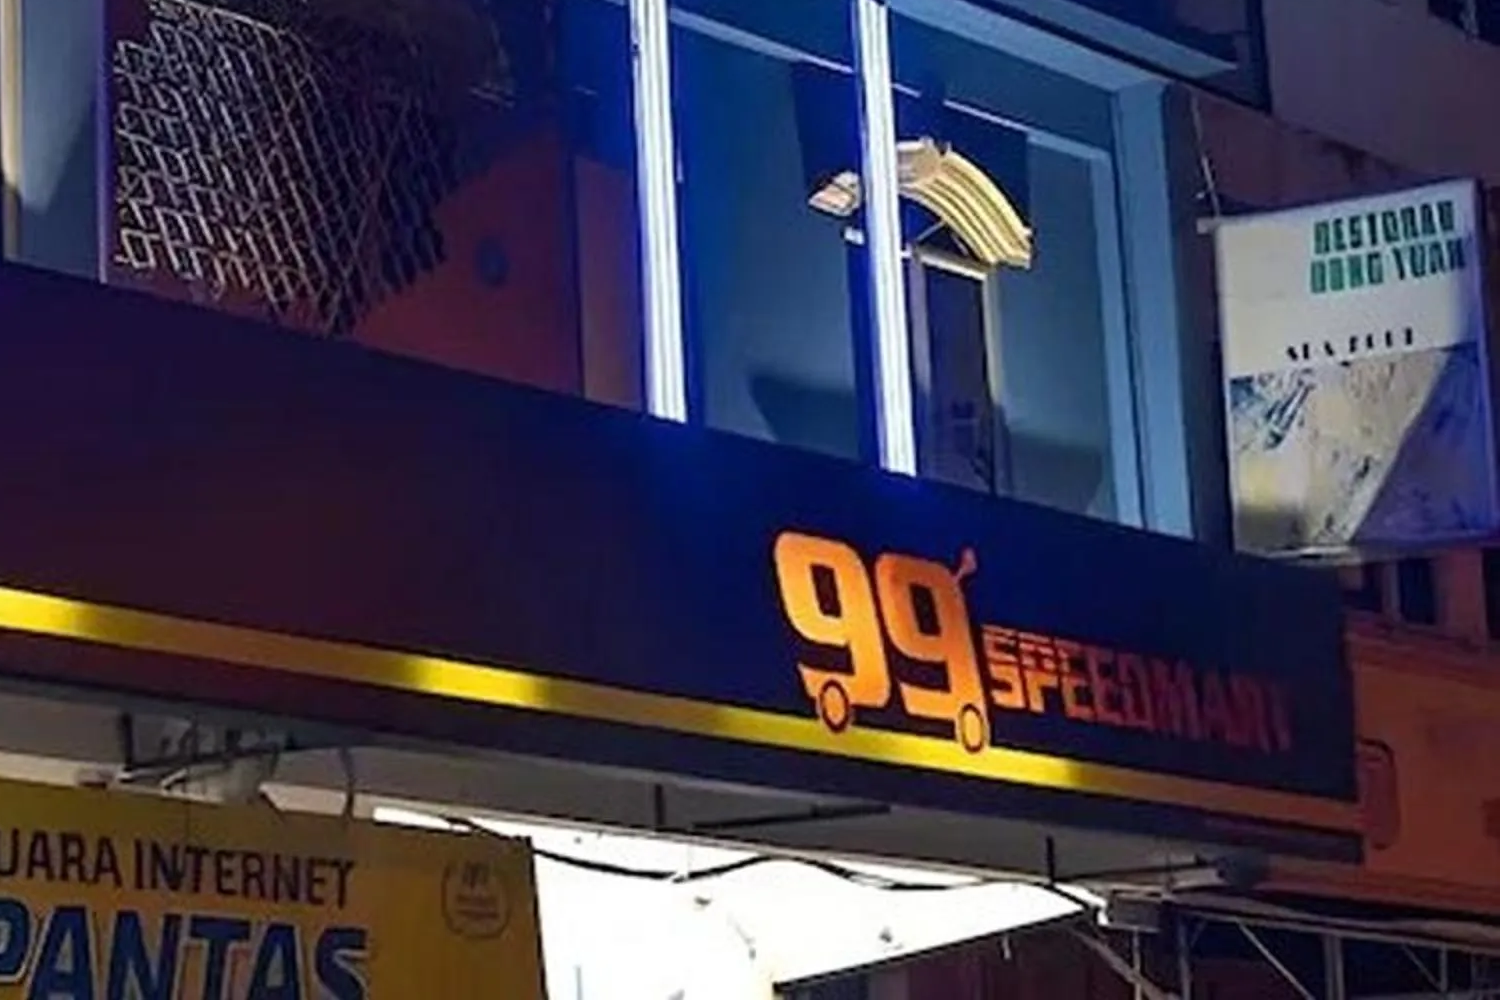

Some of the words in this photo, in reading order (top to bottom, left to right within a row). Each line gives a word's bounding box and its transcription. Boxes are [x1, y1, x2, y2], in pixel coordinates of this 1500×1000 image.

[774, 530, 990, 748] 99
[981, 624, 1293, 753] SPEEDMART
[134, 838, 356, 910] INTERNET
